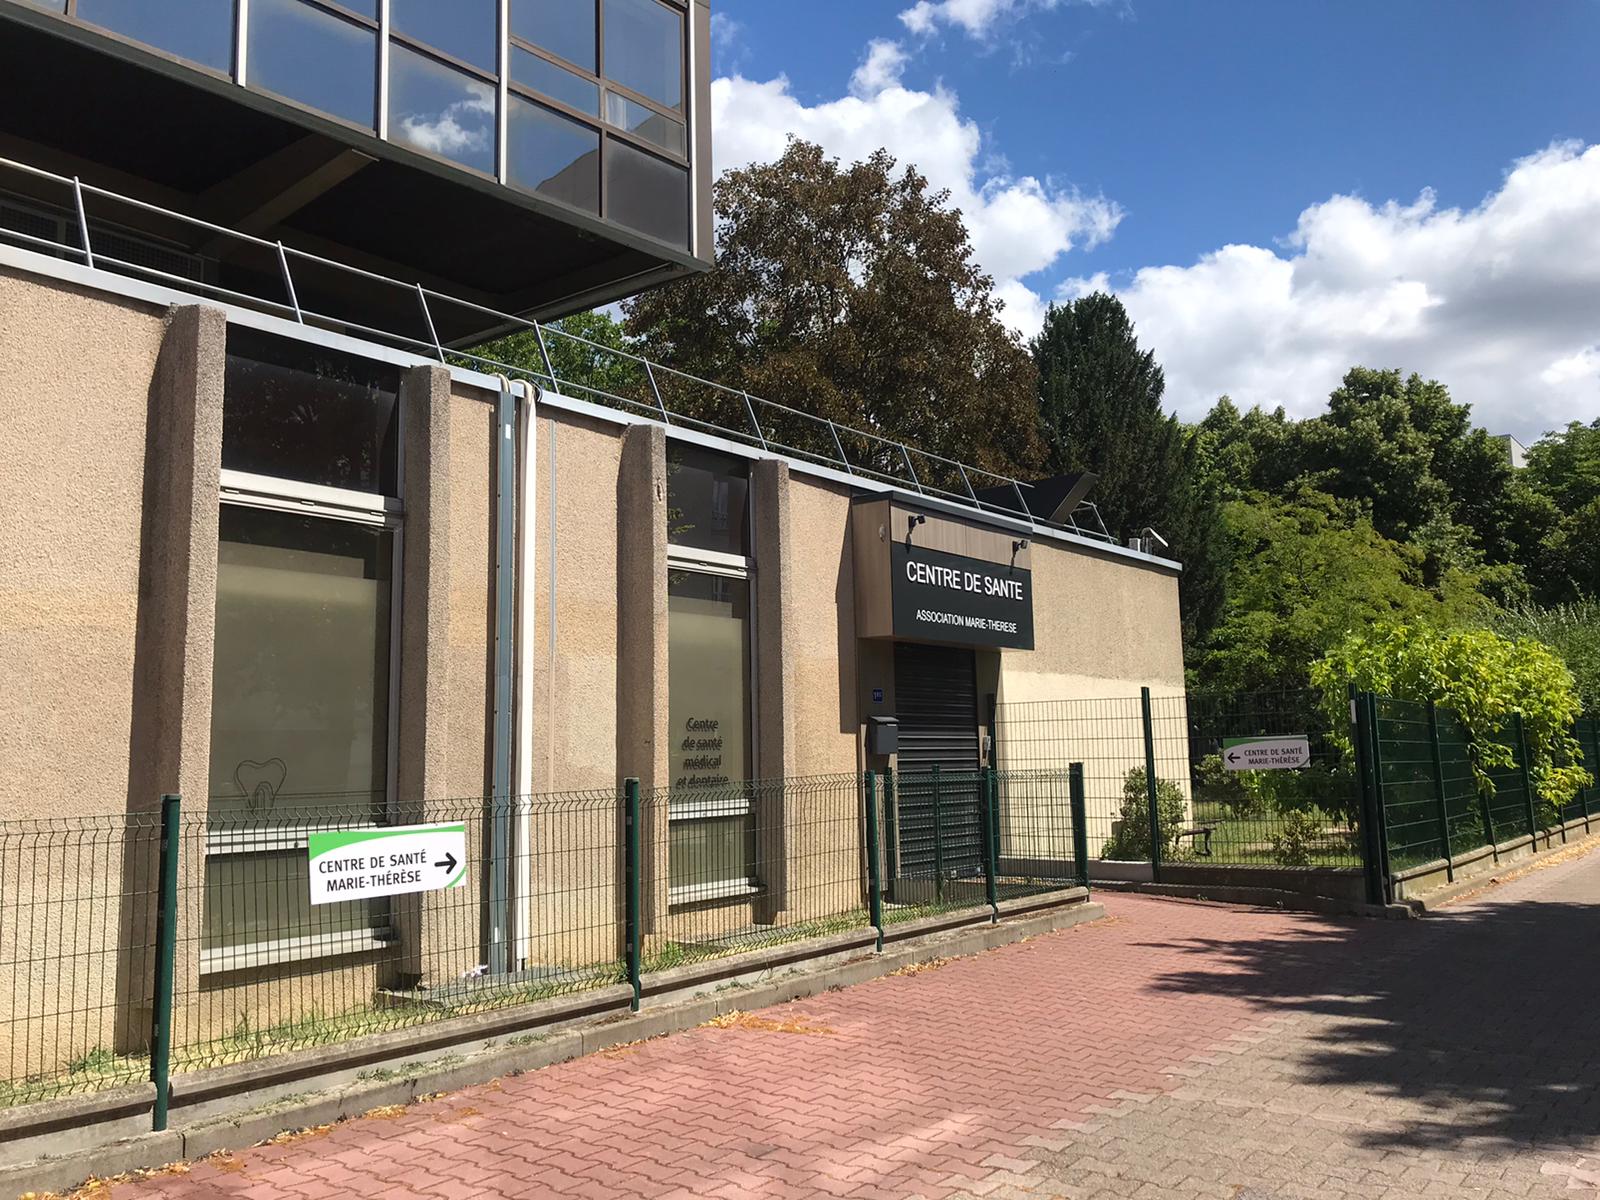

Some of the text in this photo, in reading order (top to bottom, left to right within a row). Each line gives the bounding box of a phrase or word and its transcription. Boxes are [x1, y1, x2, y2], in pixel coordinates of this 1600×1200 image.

[906, 561, 1023, 600] CENTRE DE SANTE
[916, 609, 1018, 634] ASSOCIATION MARIE-THERESE
[686, 717, 719, 730] Centre
[682, 735, 723, 750] de santé
[1244, 746, 1303, 757] CENTRE DE SANTÉ
[684, 754, 722, 769] médical
[319, 849, 427, 873] CENTRE DE SANTÉ
[326, 869, 422, 892] MARIE-THÉRÈSE
